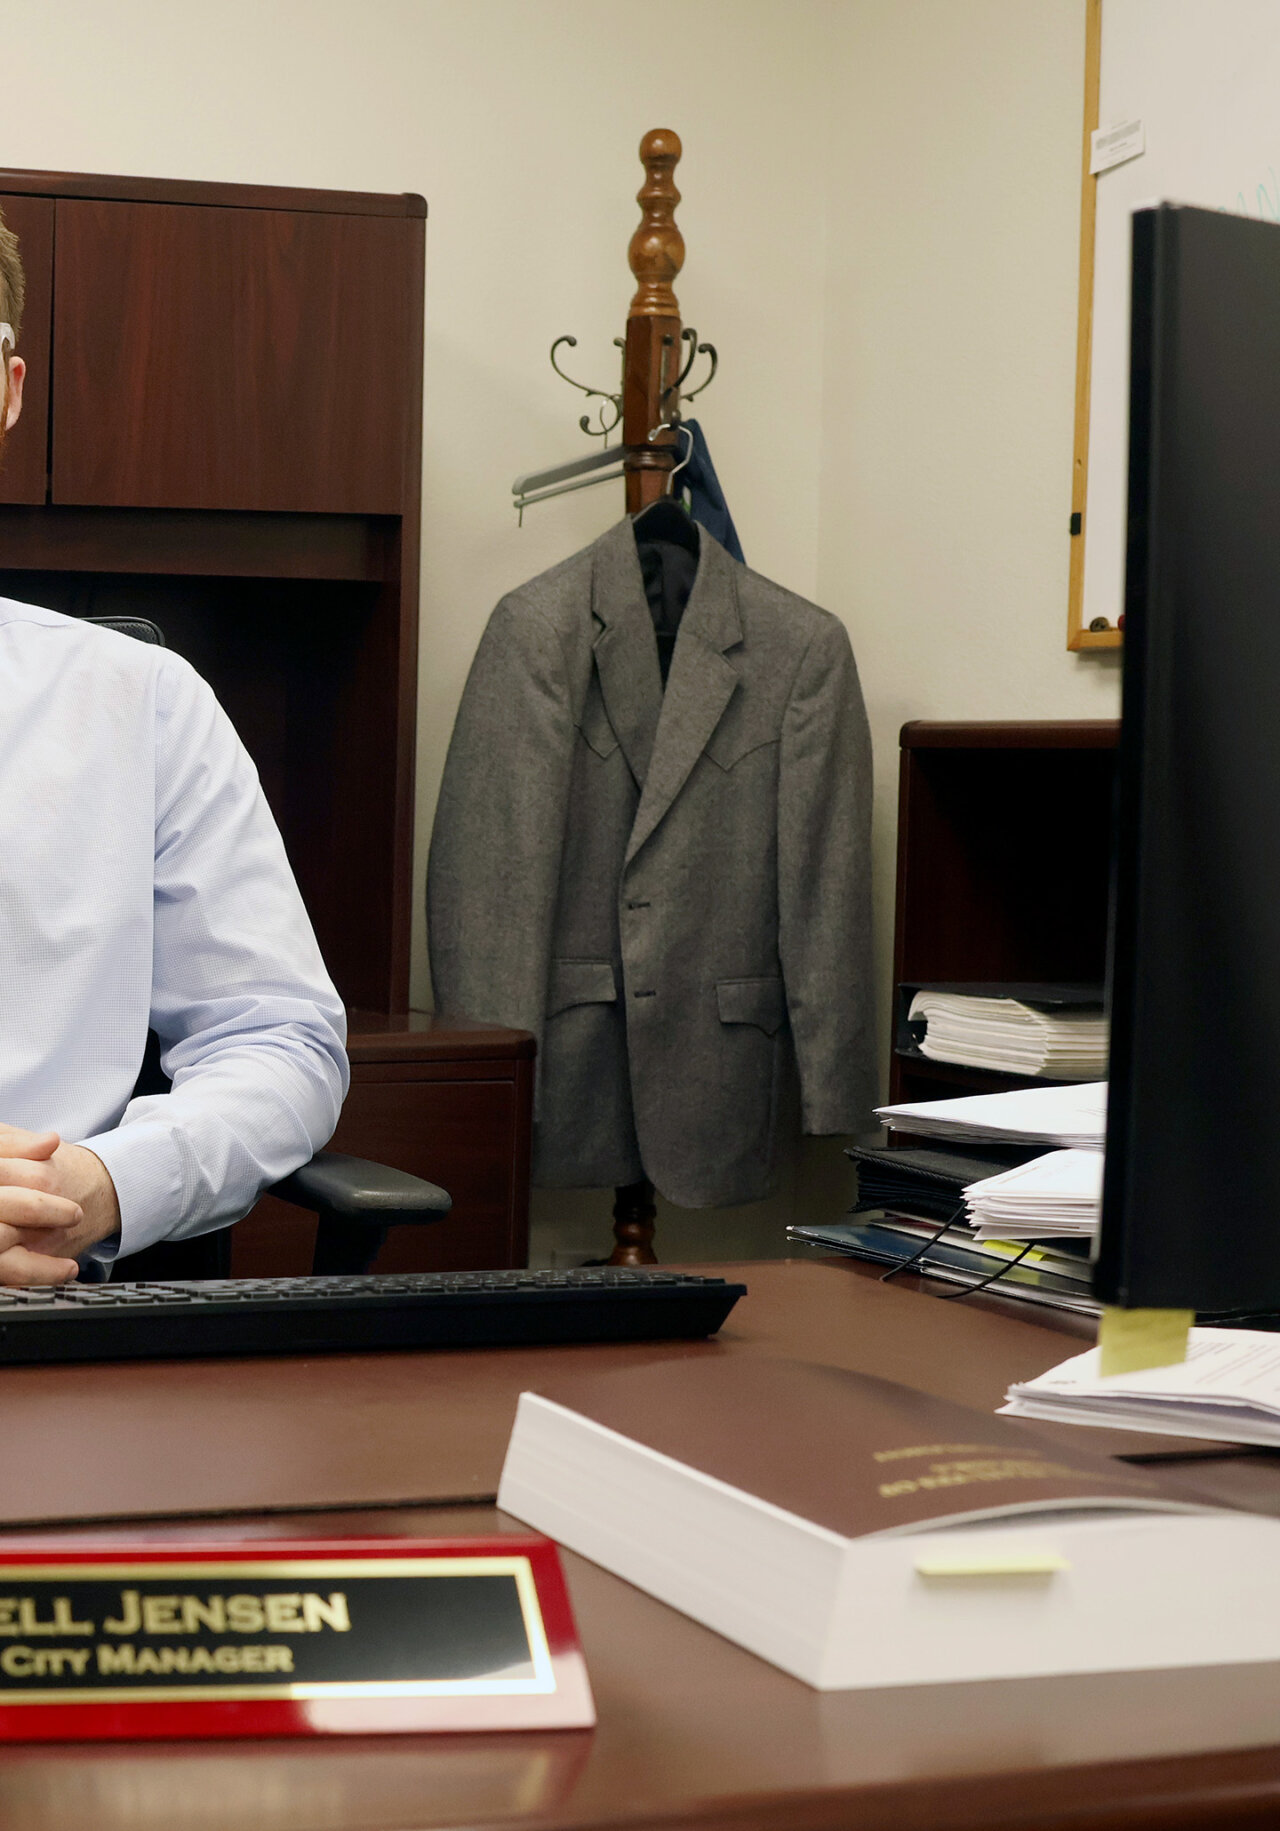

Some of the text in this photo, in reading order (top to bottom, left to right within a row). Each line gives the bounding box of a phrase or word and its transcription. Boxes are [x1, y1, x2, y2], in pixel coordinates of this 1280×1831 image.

[103, 1590, 351, 1636] JENSEN
[0, 1644, 295, 1678] CITY MANAGER
